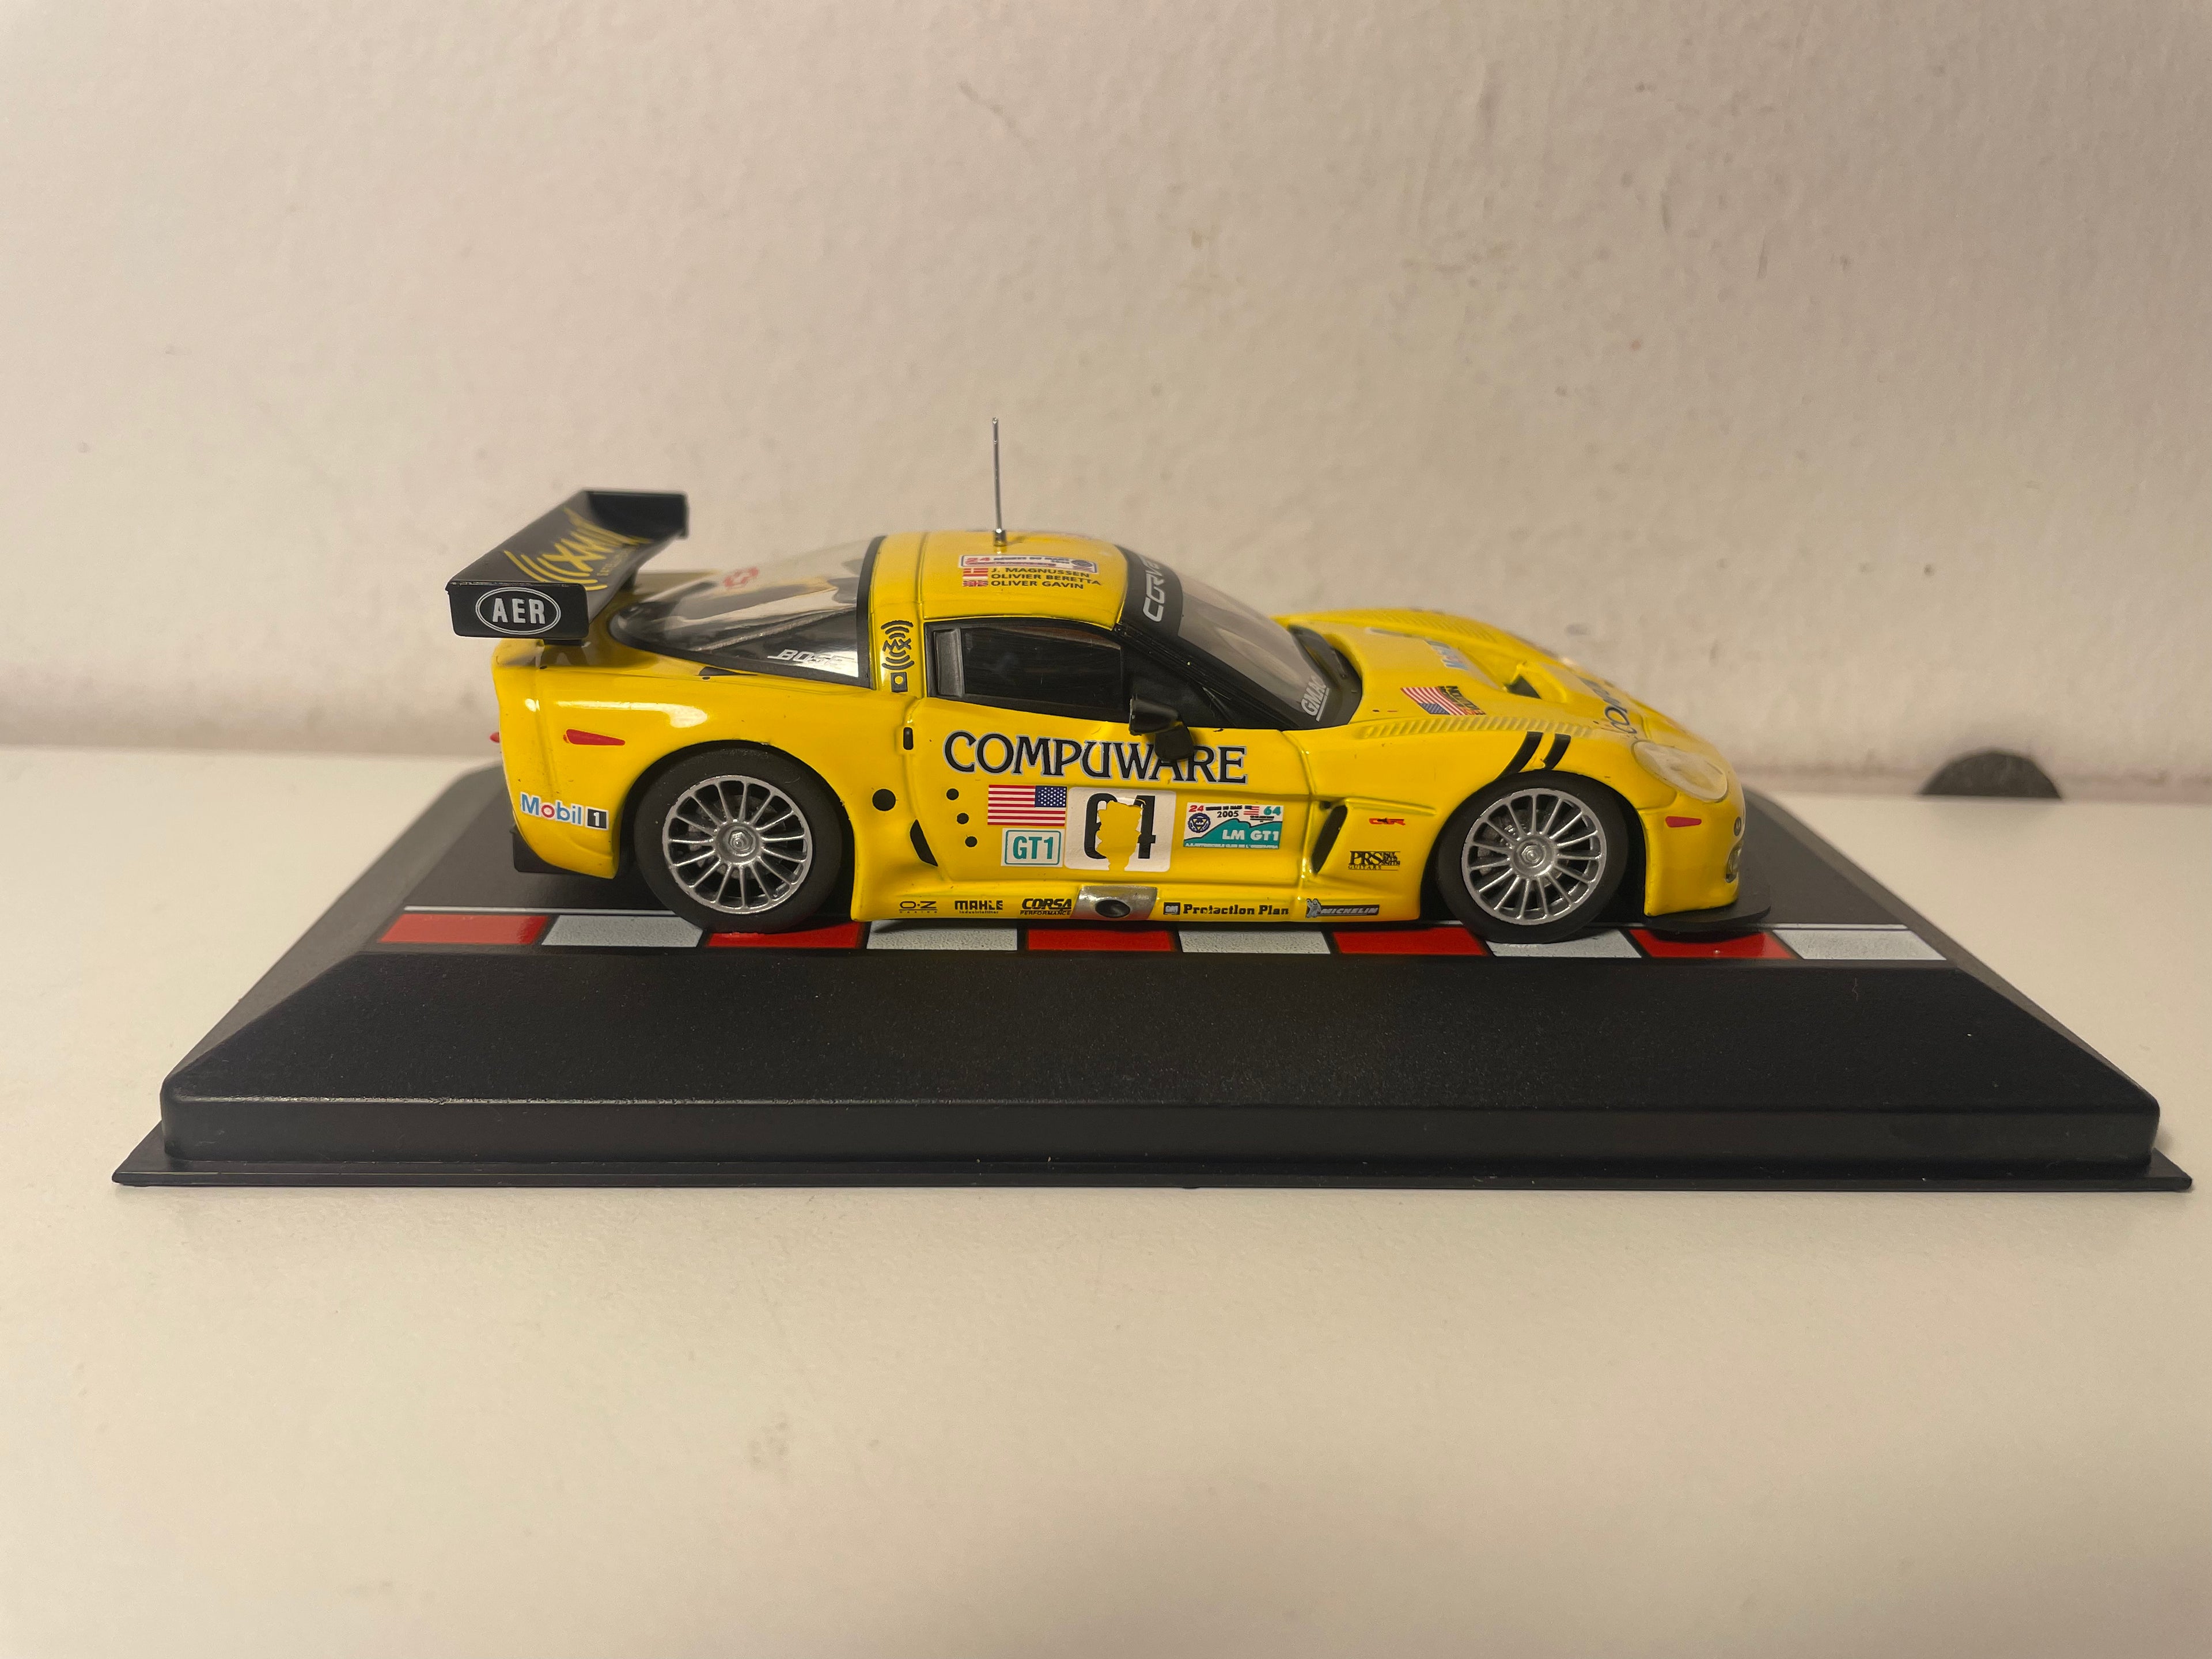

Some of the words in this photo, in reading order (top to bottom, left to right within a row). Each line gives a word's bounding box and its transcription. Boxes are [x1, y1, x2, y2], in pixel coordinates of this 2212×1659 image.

[1005, 567, 1090, 578] MAGNUSSEN
[1041, 581, 1084, 589] GAVIN
[1046, 575, 1101, 586] BERETTA
[493, 597, 546, 624] AER
[1301, 675, 1327, 716] GMAC
[944, 730, 1249, 785] COMPUWARE
[521, 793, 582, 825] Mobil
[1264, 806, 1281, 816] 64
[1222, 830, 1245, 840] LM
[1250, 830, 1279, 841] GT1
[1013, 836, 1054, 859] GT1
[1349, 852, 1383, 864] PRS
[955, 900, 1003, 910] MAHLE
[1022, 898, 1071, 910] CORSA
[1258, 905, 1289, 915] Plan
